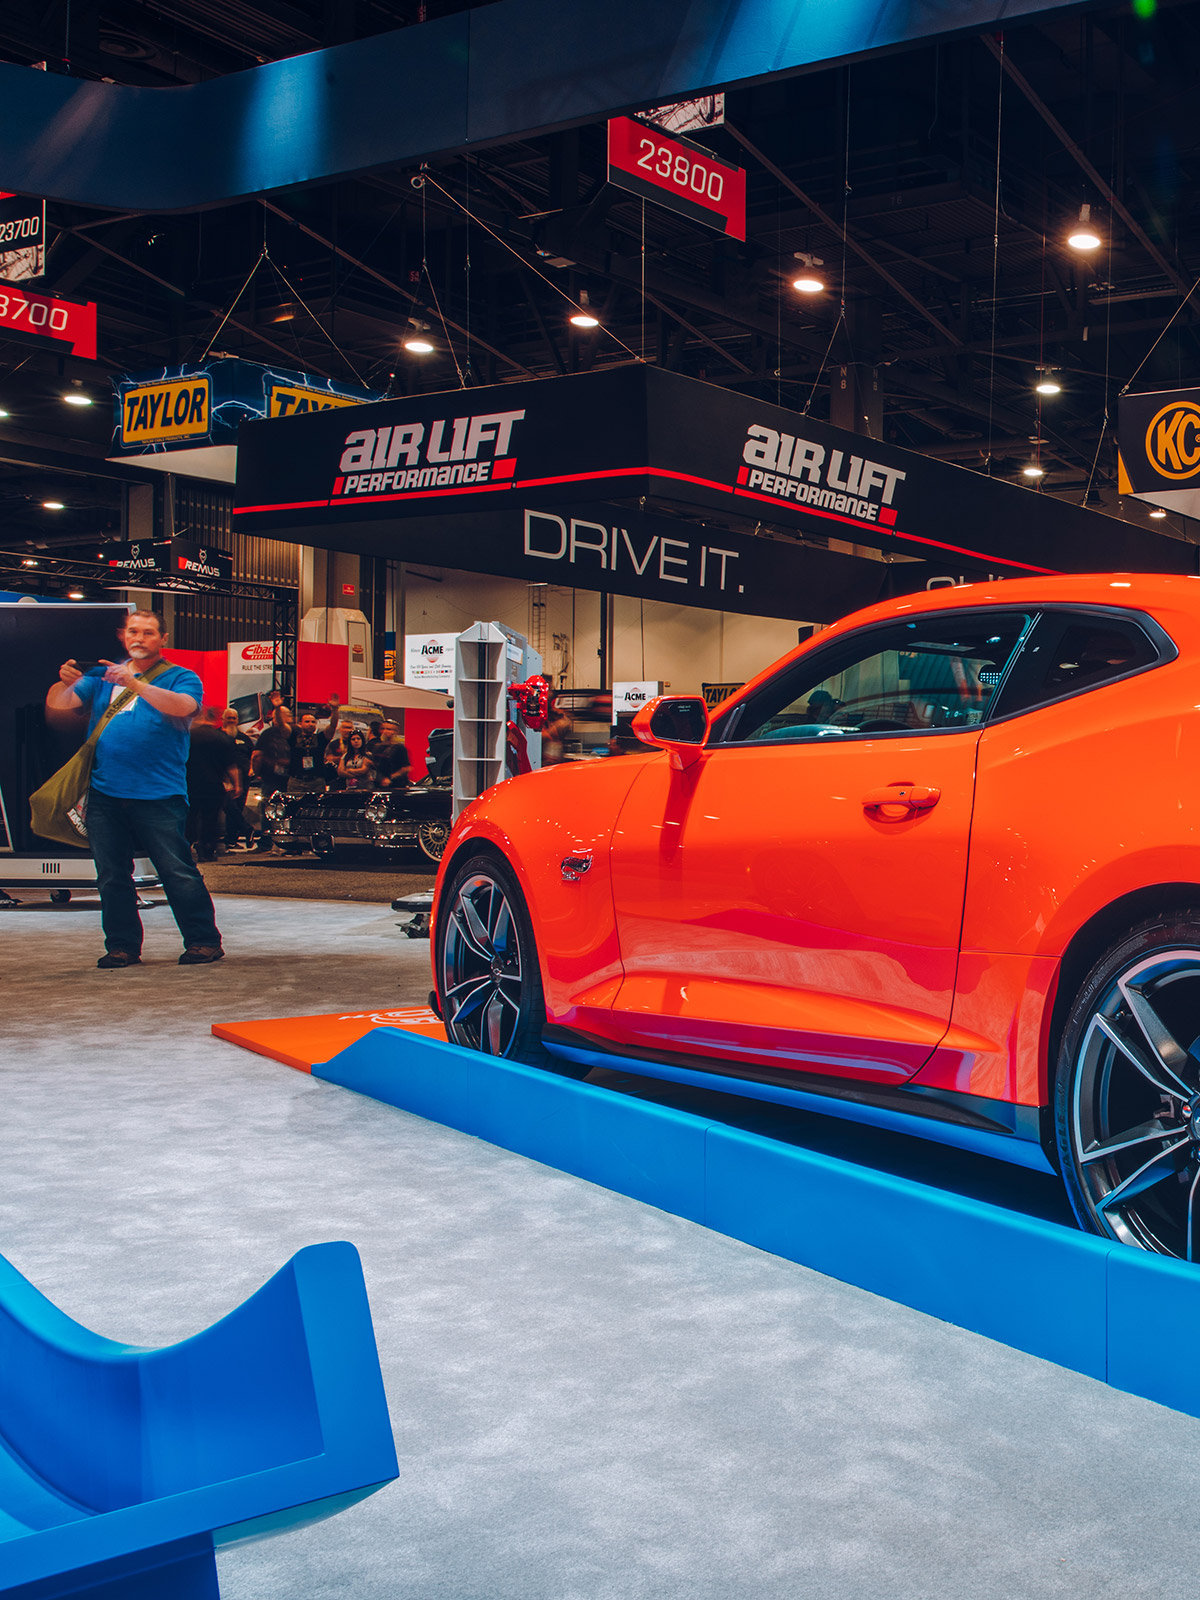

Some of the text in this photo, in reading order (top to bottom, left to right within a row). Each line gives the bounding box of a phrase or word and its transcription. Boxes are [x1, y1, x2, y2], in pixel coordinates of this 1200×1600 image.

[637, 138, 724, 202] 23800
[126, 387, 206, 432] TAYLOR
[426, 409, 526, 464] LIFT
[343, 461, 492, 495] PERFORMANCE
[748, 468, 879, 522] PERFORMANCE
[826, 449, 907, 505] LIFT
[185, 560, 220, 577] REMUS
[524, 508, 745, 594] DRIVE IT.
[421, 644, 444, 656] ACME
[624, 691, 646, 701] ACME
